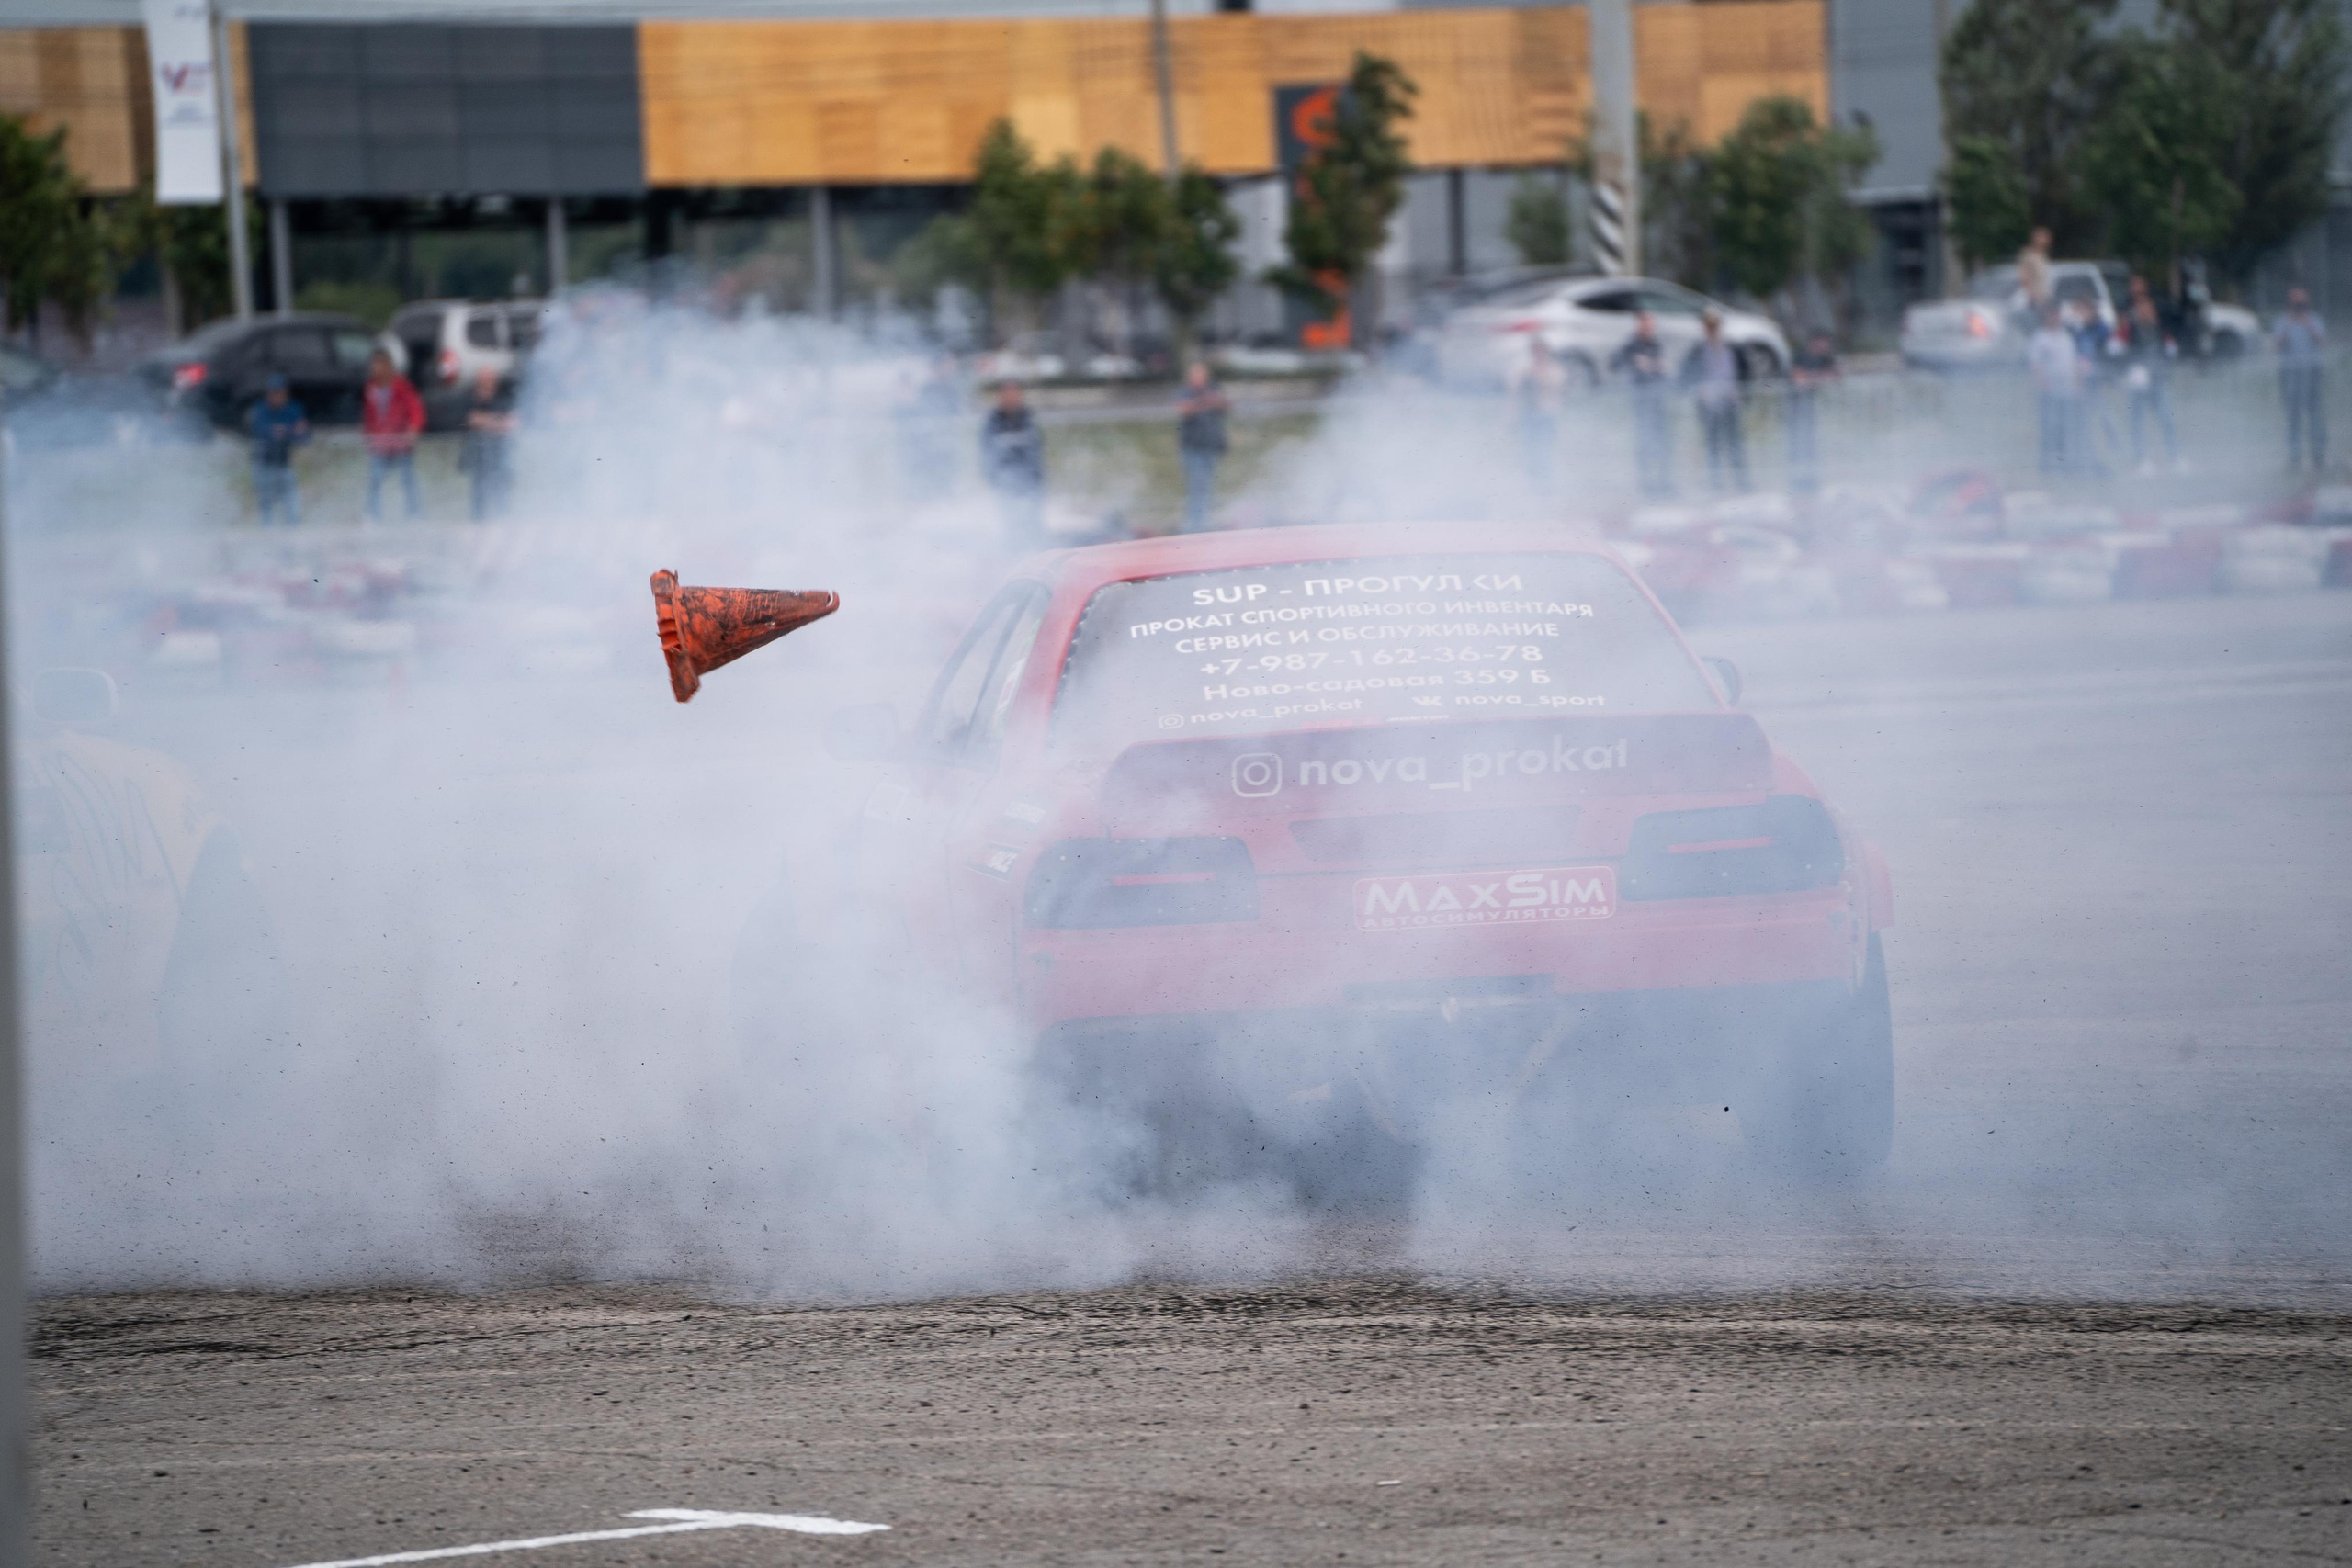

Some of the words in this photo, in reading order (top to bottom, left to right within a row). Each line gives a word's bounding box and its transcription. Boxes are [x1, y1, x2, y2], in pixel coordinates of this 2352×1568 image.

[1193, 583, 1268, 605] SUP
[1129, 612, 1234, 638] ПРОКАТ
[1241, 602, 1437, 625] СПОРТИВНОГО
[1443, 601, 1594, 617] ИНВЕНТАРЯ
[1174, 631, 1282, 654] СЕРВИС
[1289, 629, 1310, 644] И
[1317, 622, 1560, 642] ОБСЛУЖИВАНИЕ
[1200, 645, 1543, 676] +7-987-162-36-78
[1203, 675, 1444, 700] Ново-садовая
[1453, 670, 1519, 685] 359
[1530, 670, 1551, 684] Б
[1190, 698, 1363, 724] nova_prokat
[1454, 694, 1606, 708] nova_sport
[1363, 904, 1609, 929] АВТОСИМУЛЯТОРЫ
